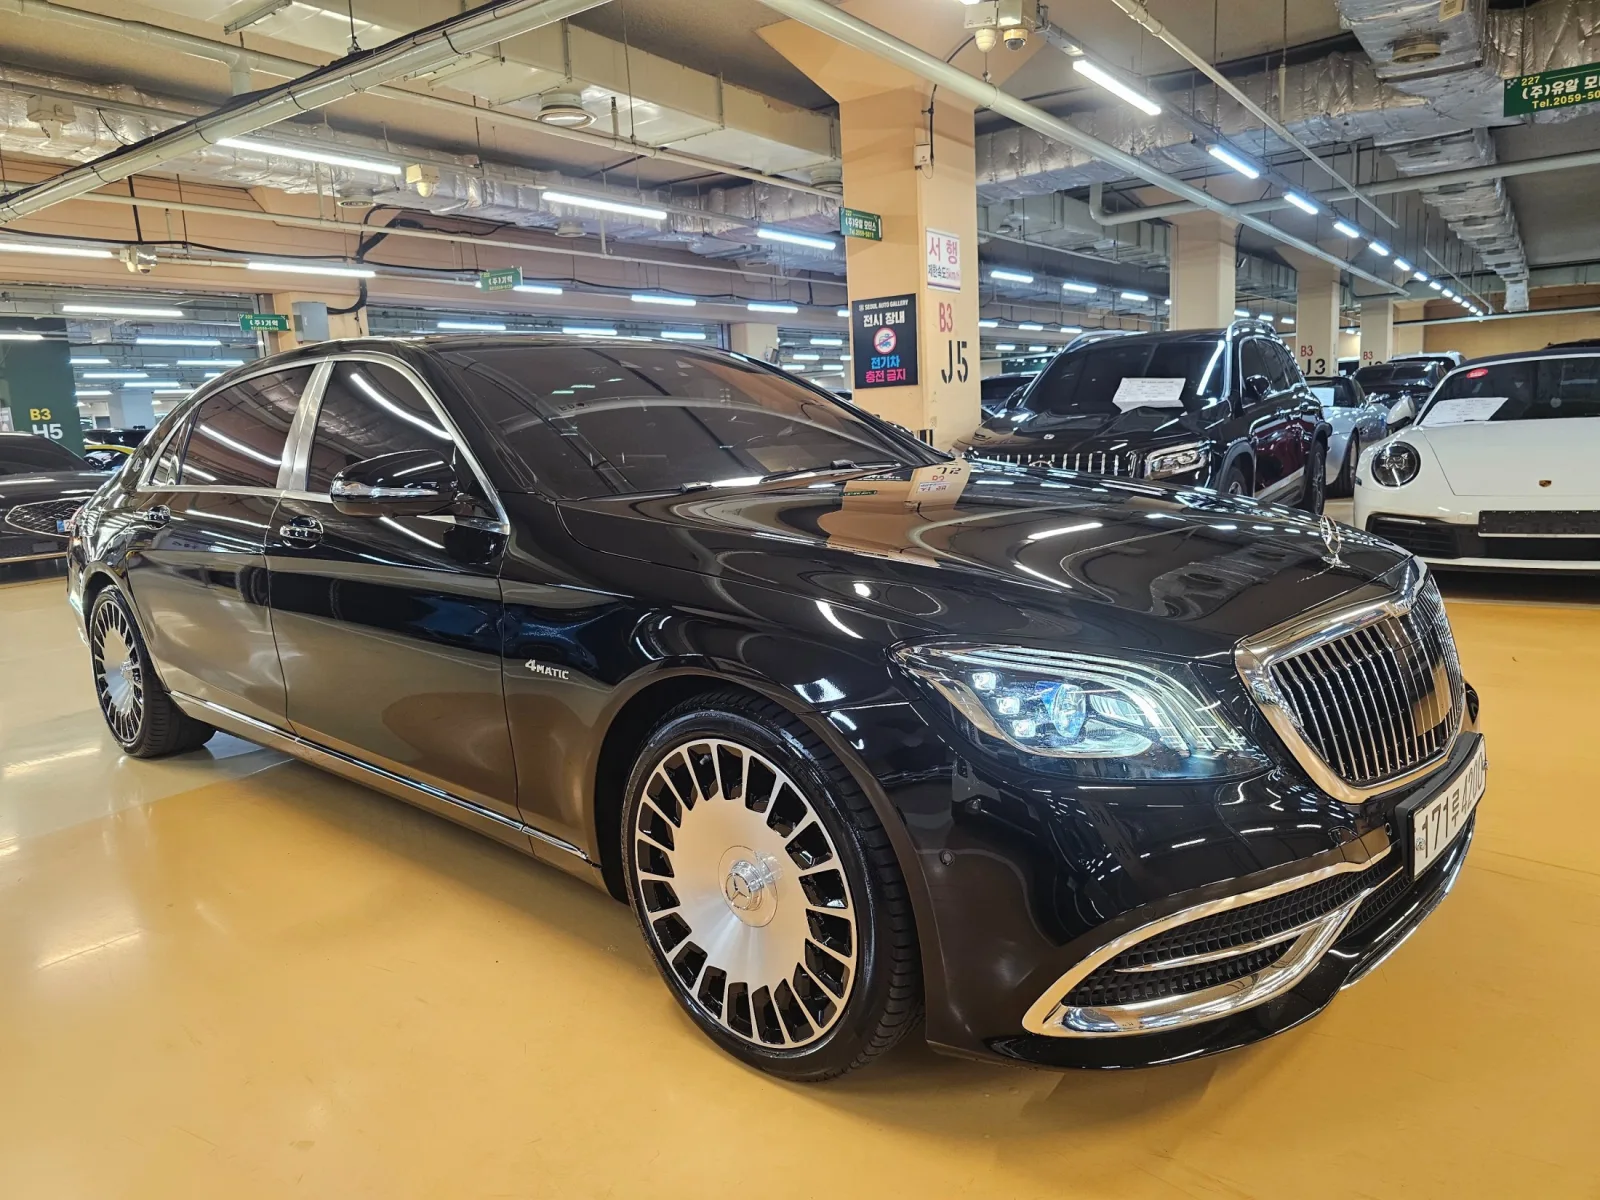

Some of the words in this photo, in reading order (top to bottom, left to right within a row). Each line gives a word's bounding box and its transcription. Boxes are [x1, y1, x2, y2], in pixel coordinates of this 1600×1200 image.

[1521, 76, 1540, 86] 227
[863, 313, 883, 328] 전시
[885, 310, 905, 325] 장내
[939, 302, 953, 332] B3
[1301, 345, 1313, 357] B3
[1363, 351, 1373, 360] B3
[871, 355, 900, 369] 전기차
[941, 340, 968, 384] J5
[865, 370, 885, 383] 충전
[887, 368, 906, 381] 금지
[30, 408, 51, 420] B3
[32, 424, 63, 440] H5
[524, 658, 569, 680] 4MATIC
